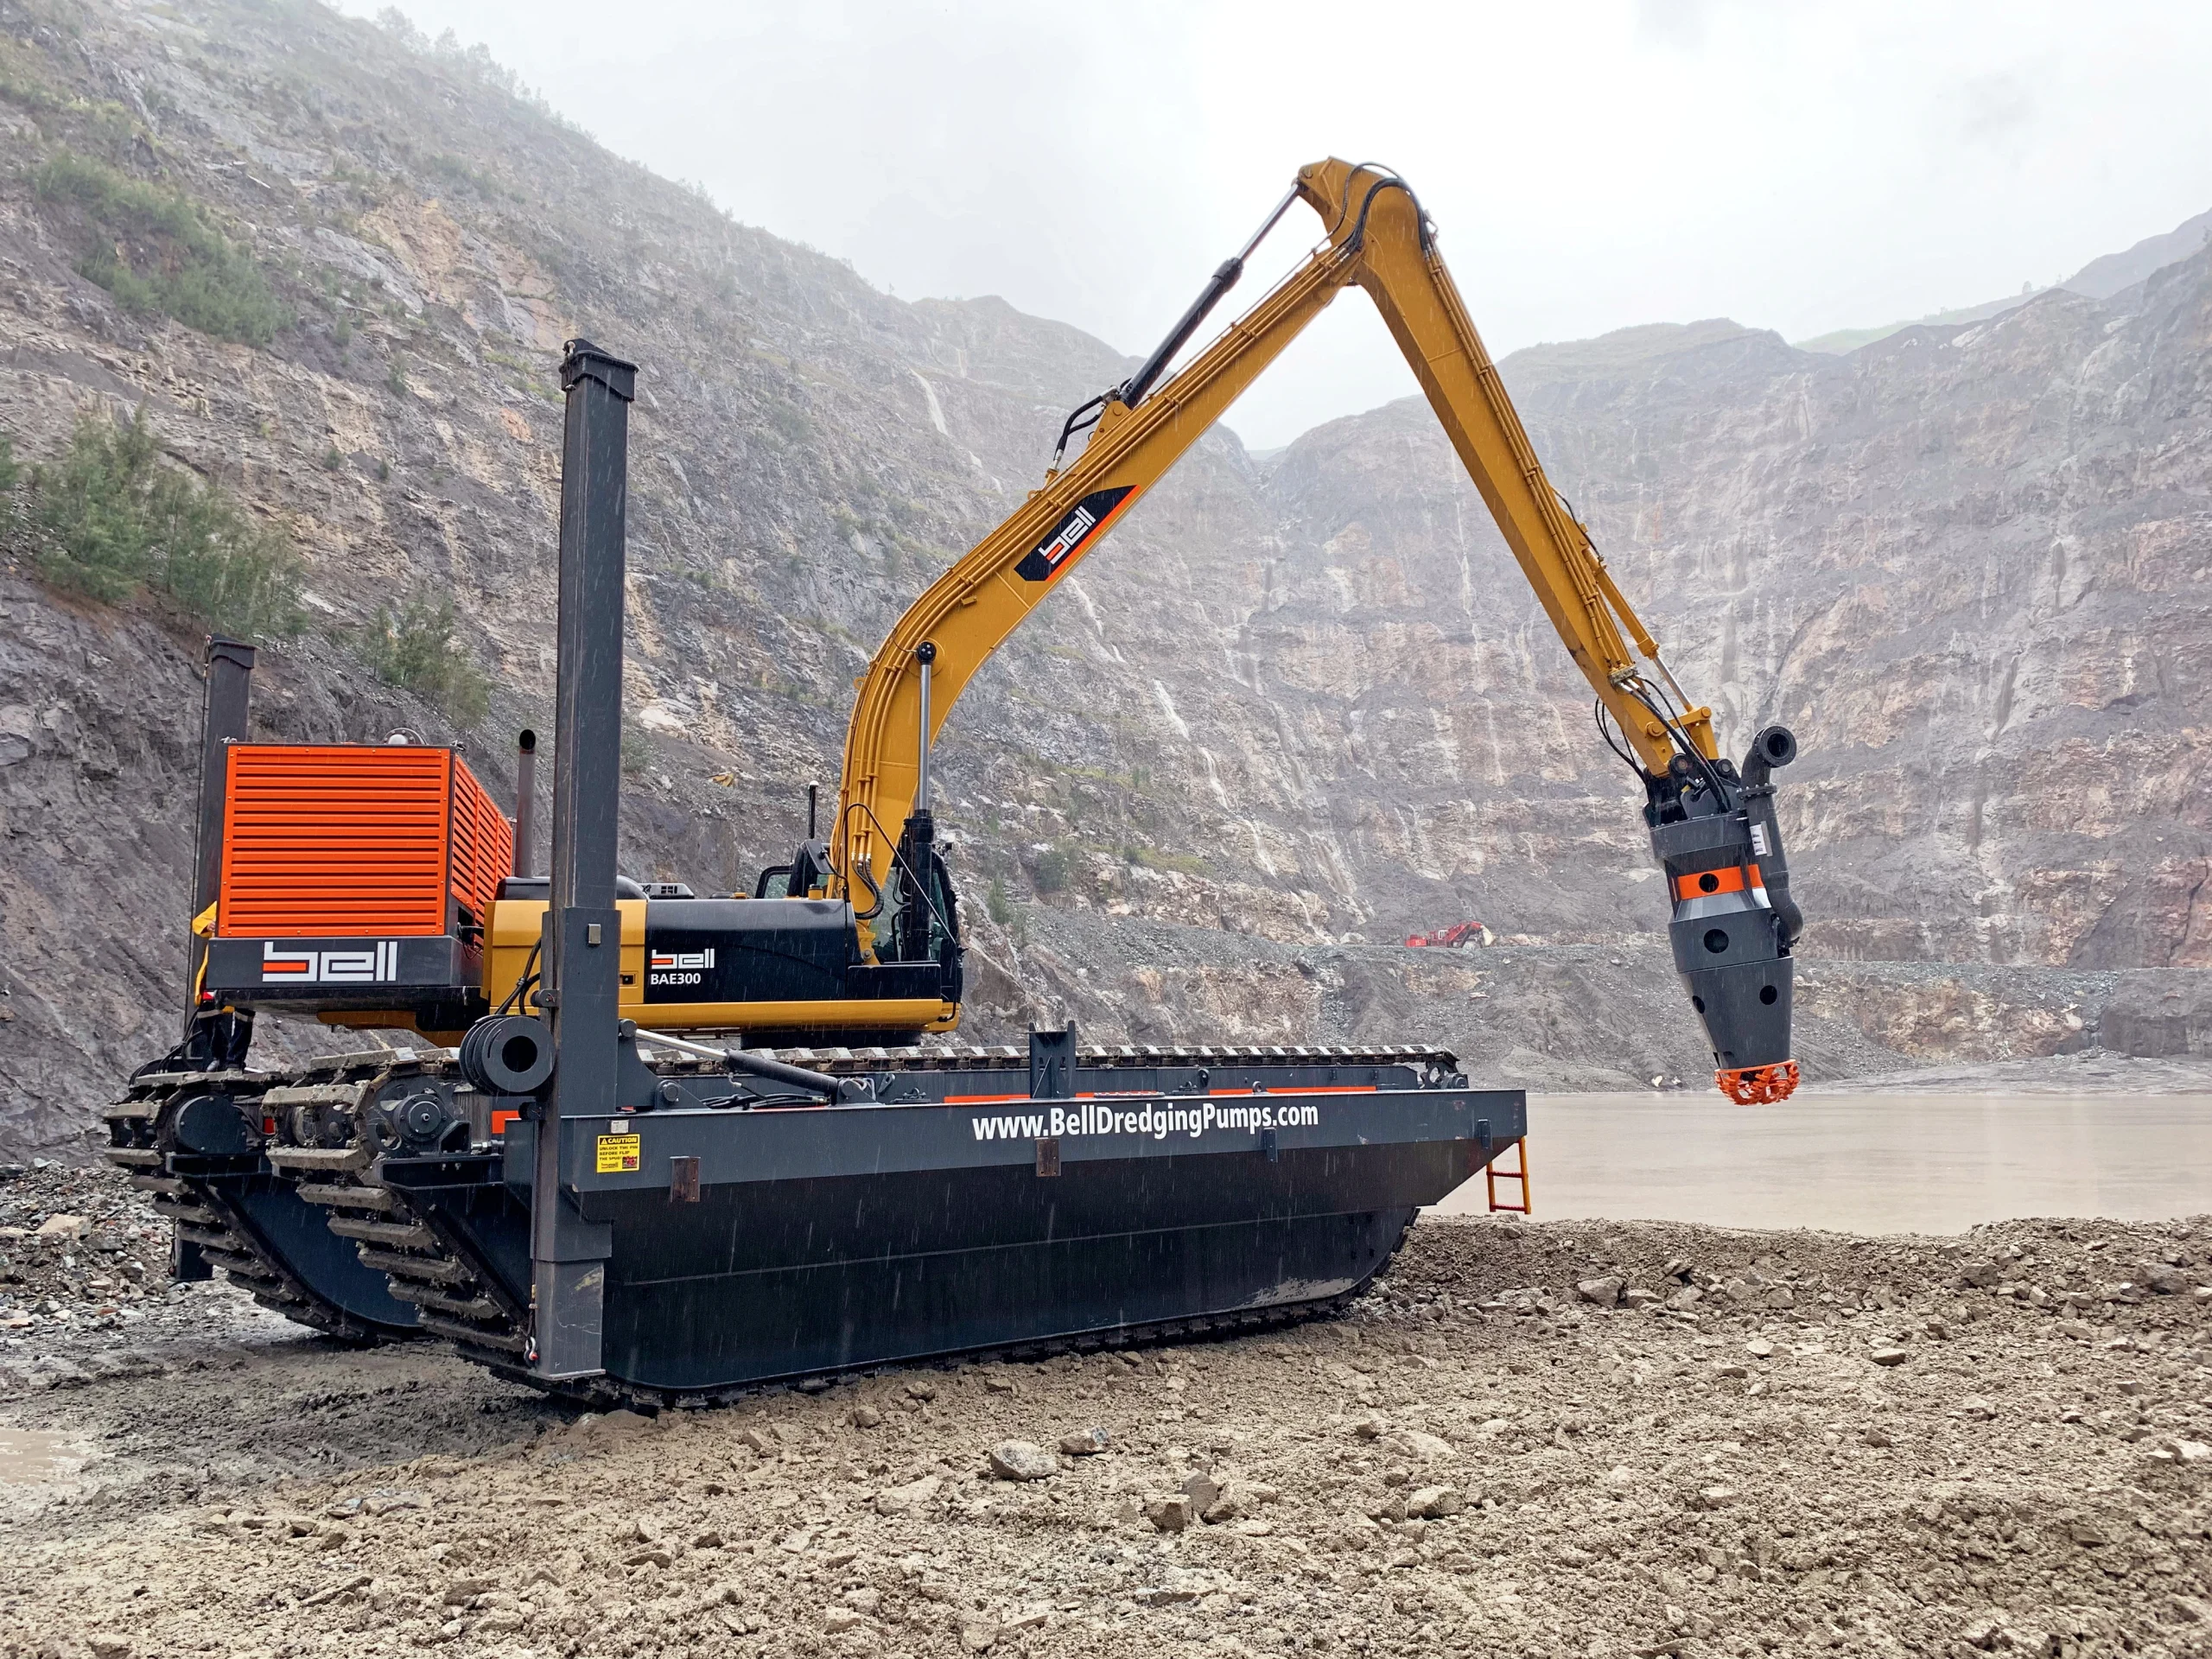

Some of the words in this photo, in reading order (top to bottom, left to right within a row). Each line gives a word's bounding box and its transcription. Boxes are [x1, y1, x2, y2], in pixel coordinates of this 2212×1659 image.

[1038, 505, 1096, 564] bell
[262, 941, 397, 982] bell
[651, 948, 715, 969] bell
[651, 973, 701, 985] BAE300
[972, 1103, 1319, 1141] www.BellDredgingPumps.com
